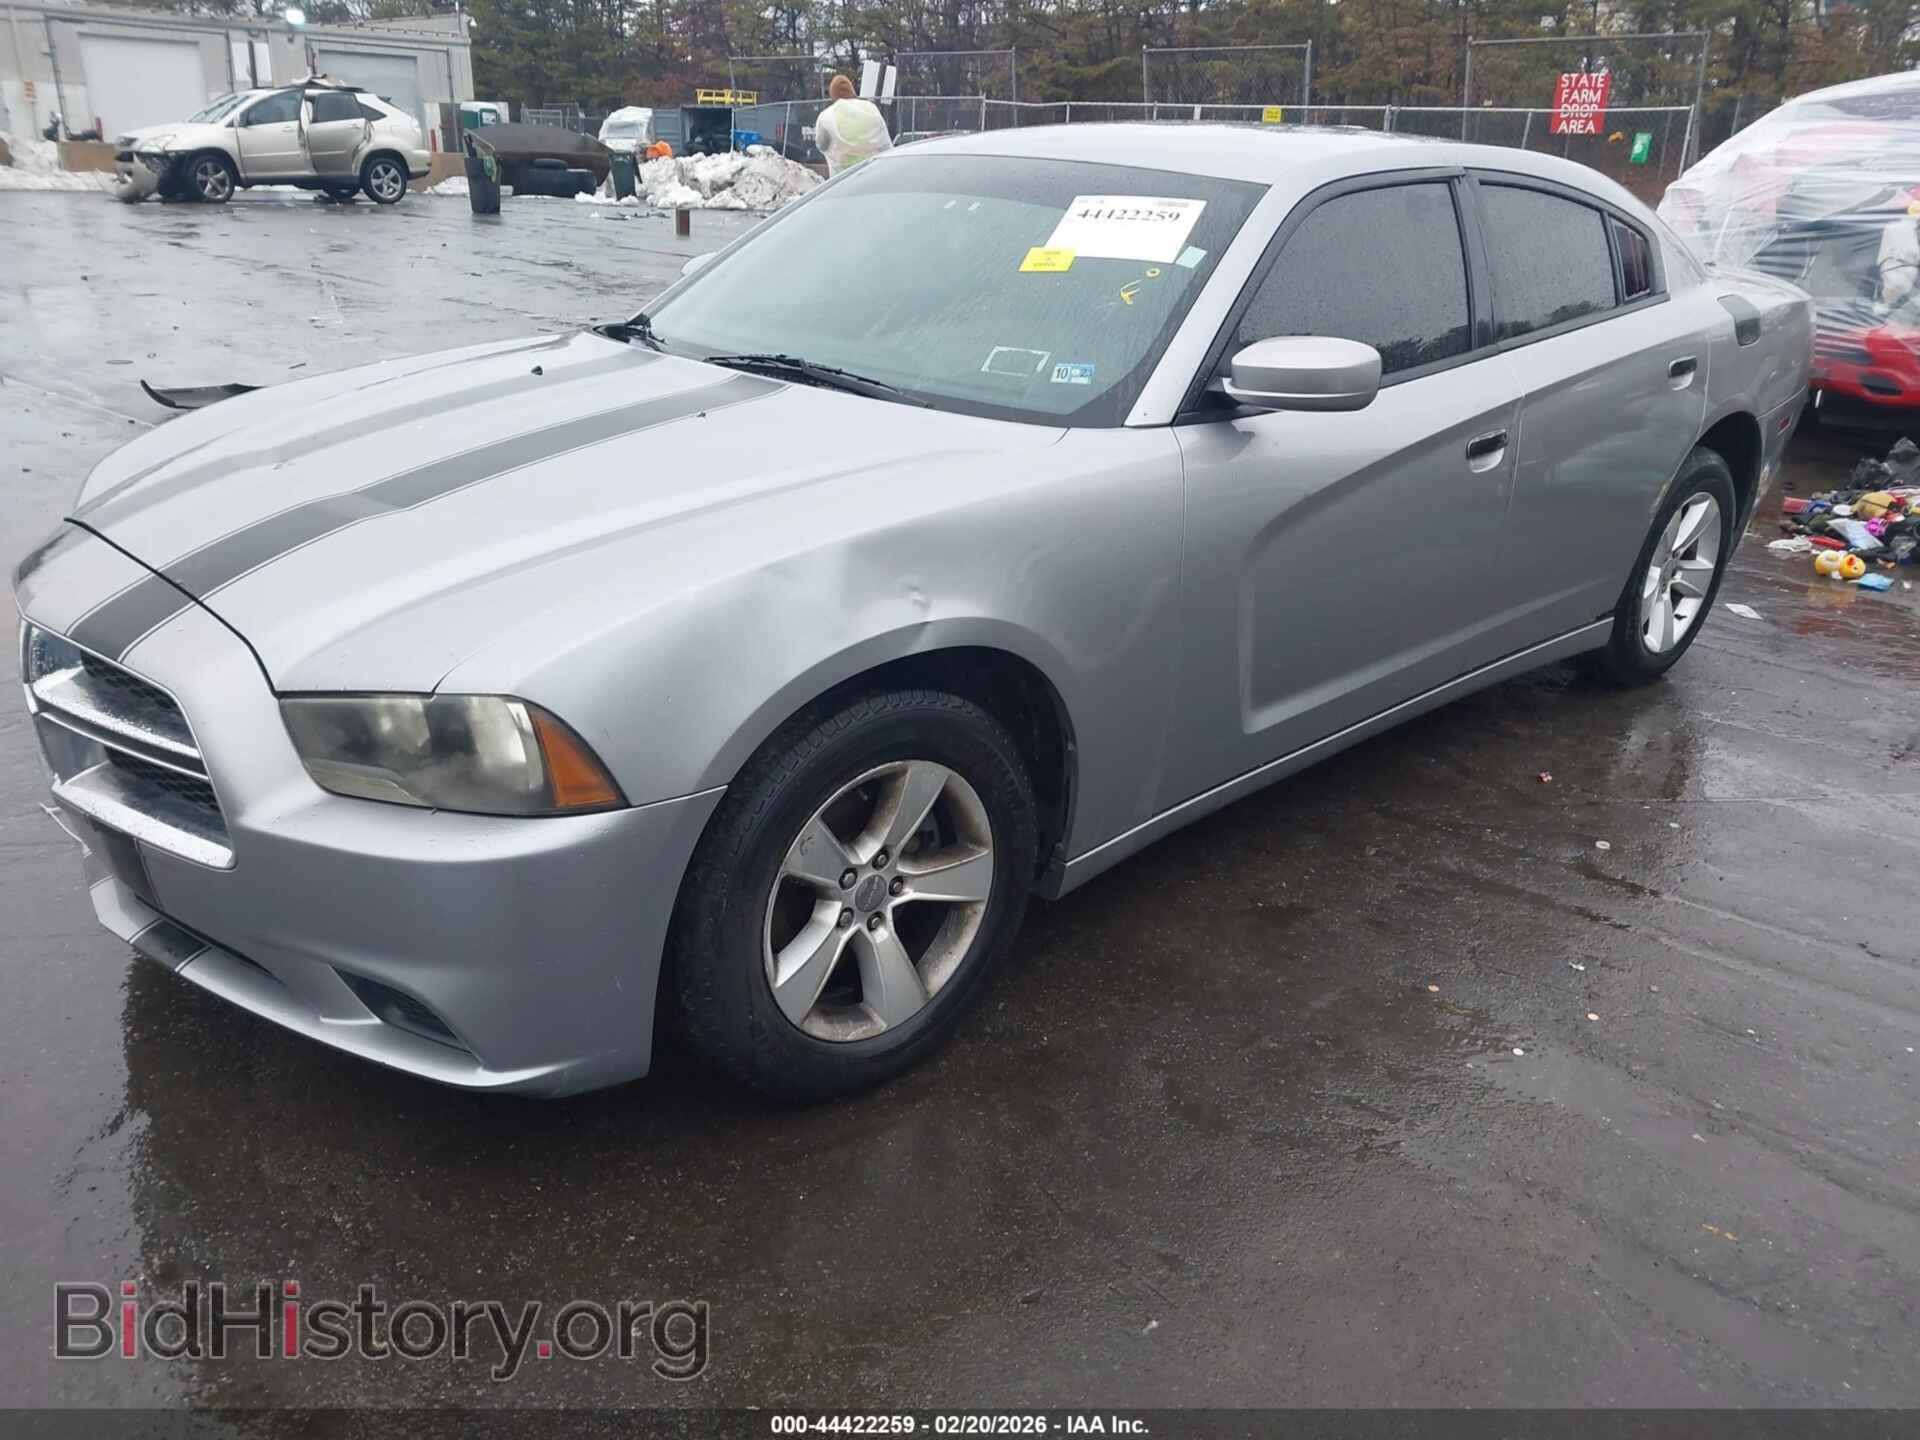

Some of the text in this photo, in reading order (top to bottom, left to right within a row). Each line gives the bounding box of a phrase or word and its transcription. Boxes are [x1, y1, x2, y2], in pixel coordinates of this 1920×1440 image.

[1560, 73, 1605, 88] STATE
[1561, 88, 1602, 103] FARM
[1560, 103, 1599, 118] DROP
[1556, 119, 1596, 134] AREA
[1077, 207, 1181, 223] 44422259
[1056, 367, 1069, 380] 10
